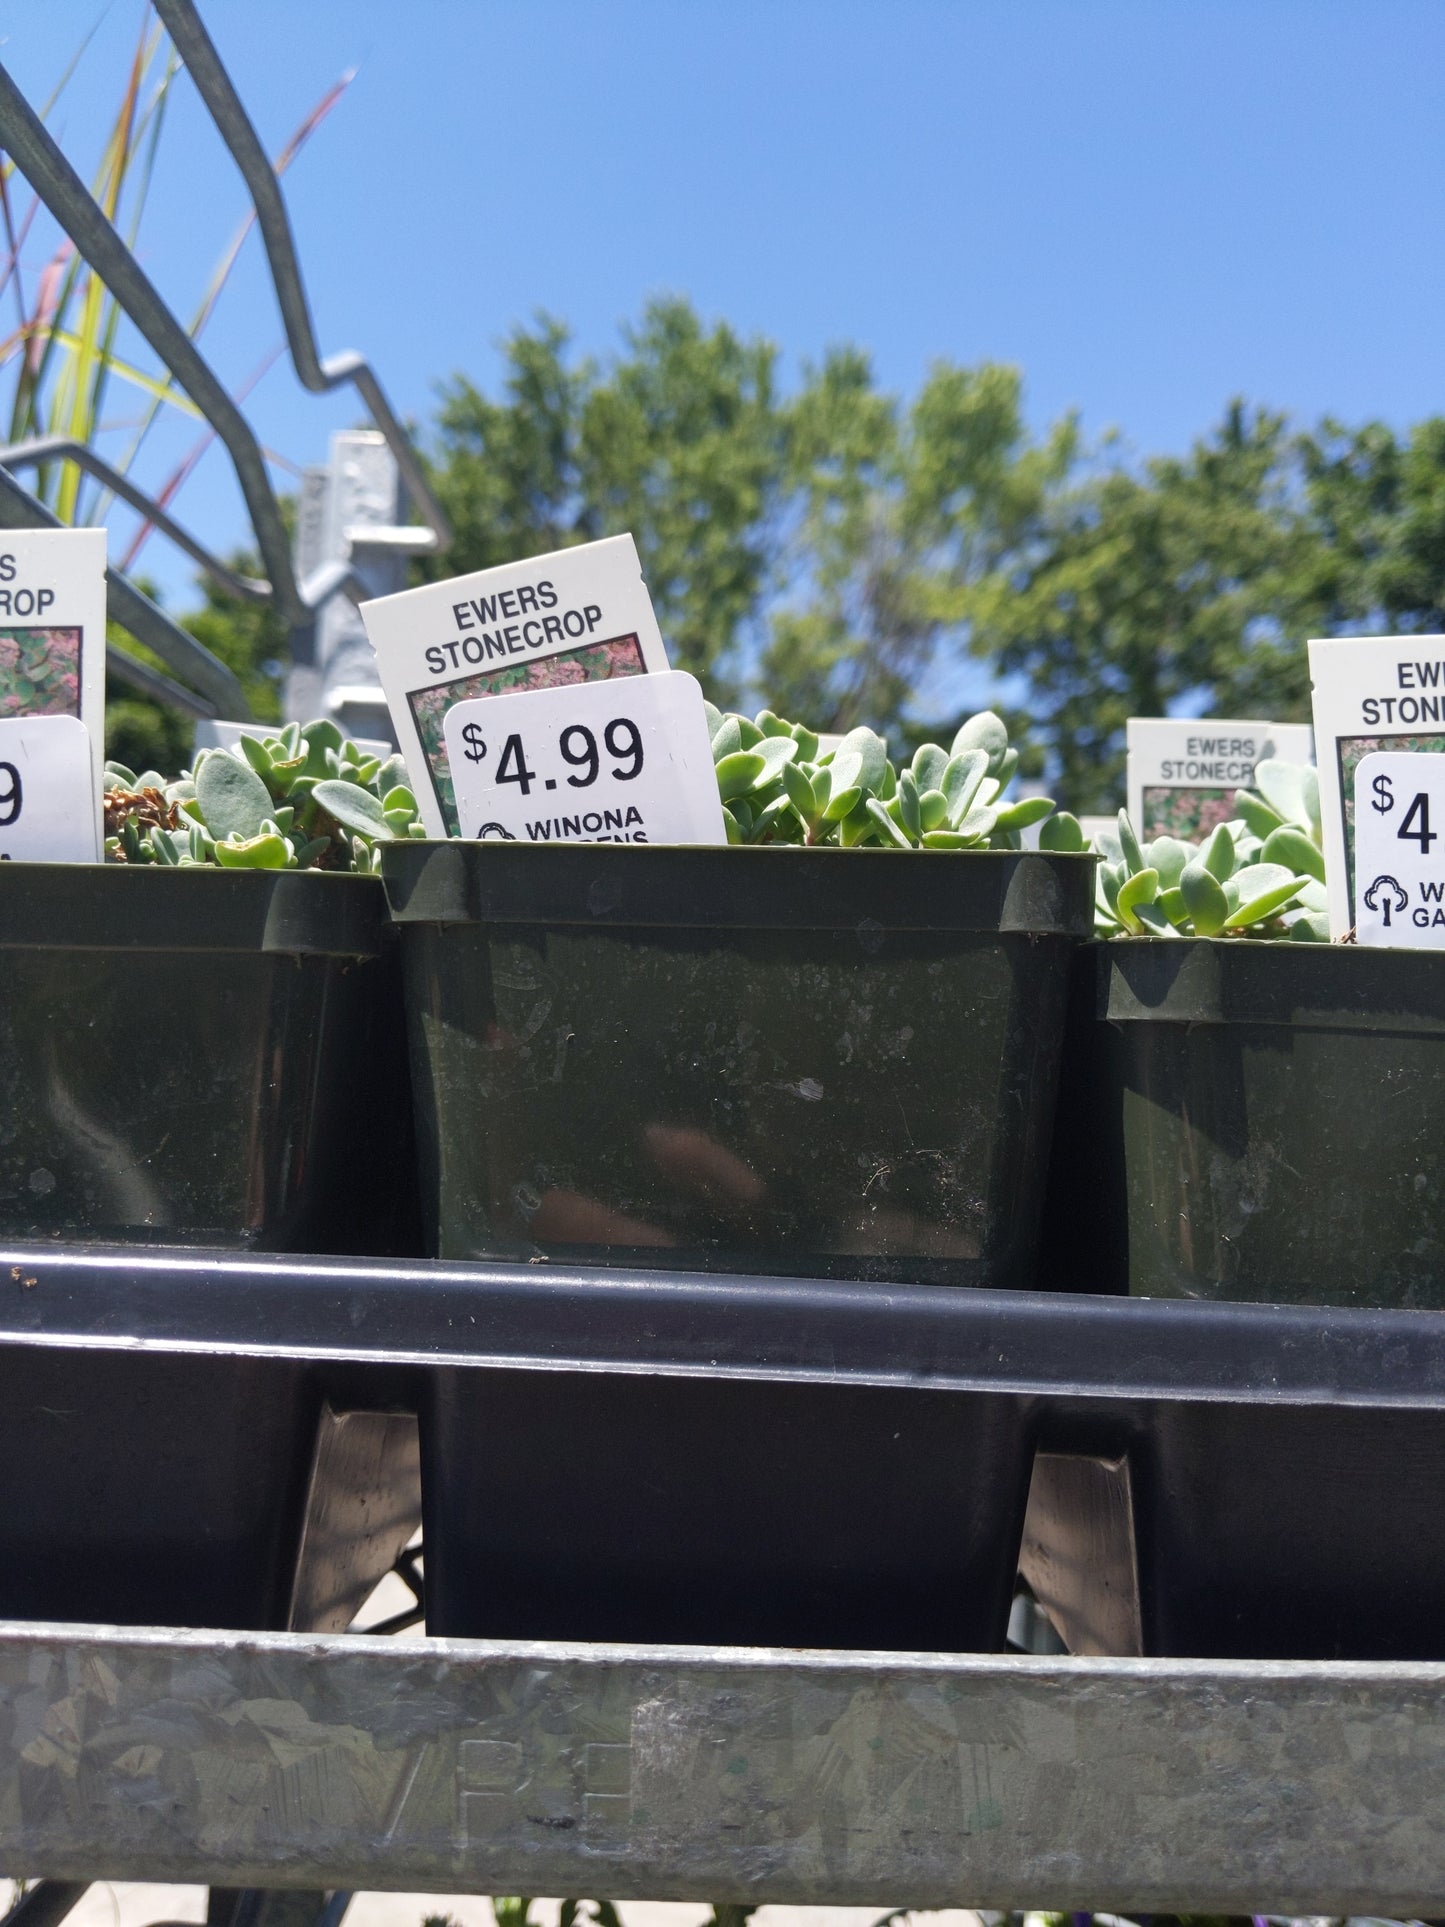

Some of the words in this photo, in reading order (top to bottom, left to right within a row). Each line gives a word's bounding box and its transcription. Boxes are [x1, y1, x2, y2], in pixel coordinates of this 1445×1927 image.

[452, 580, 559, 631] EWERS
[425, 604, 603, 675] STONECROP
[1397, 661, 1445, 689] EW
[1186, 737, 1256, 758] EWERS
[1160, 760, 1255, 781] STONECR
[525, 806, 645, 841] WINONA
